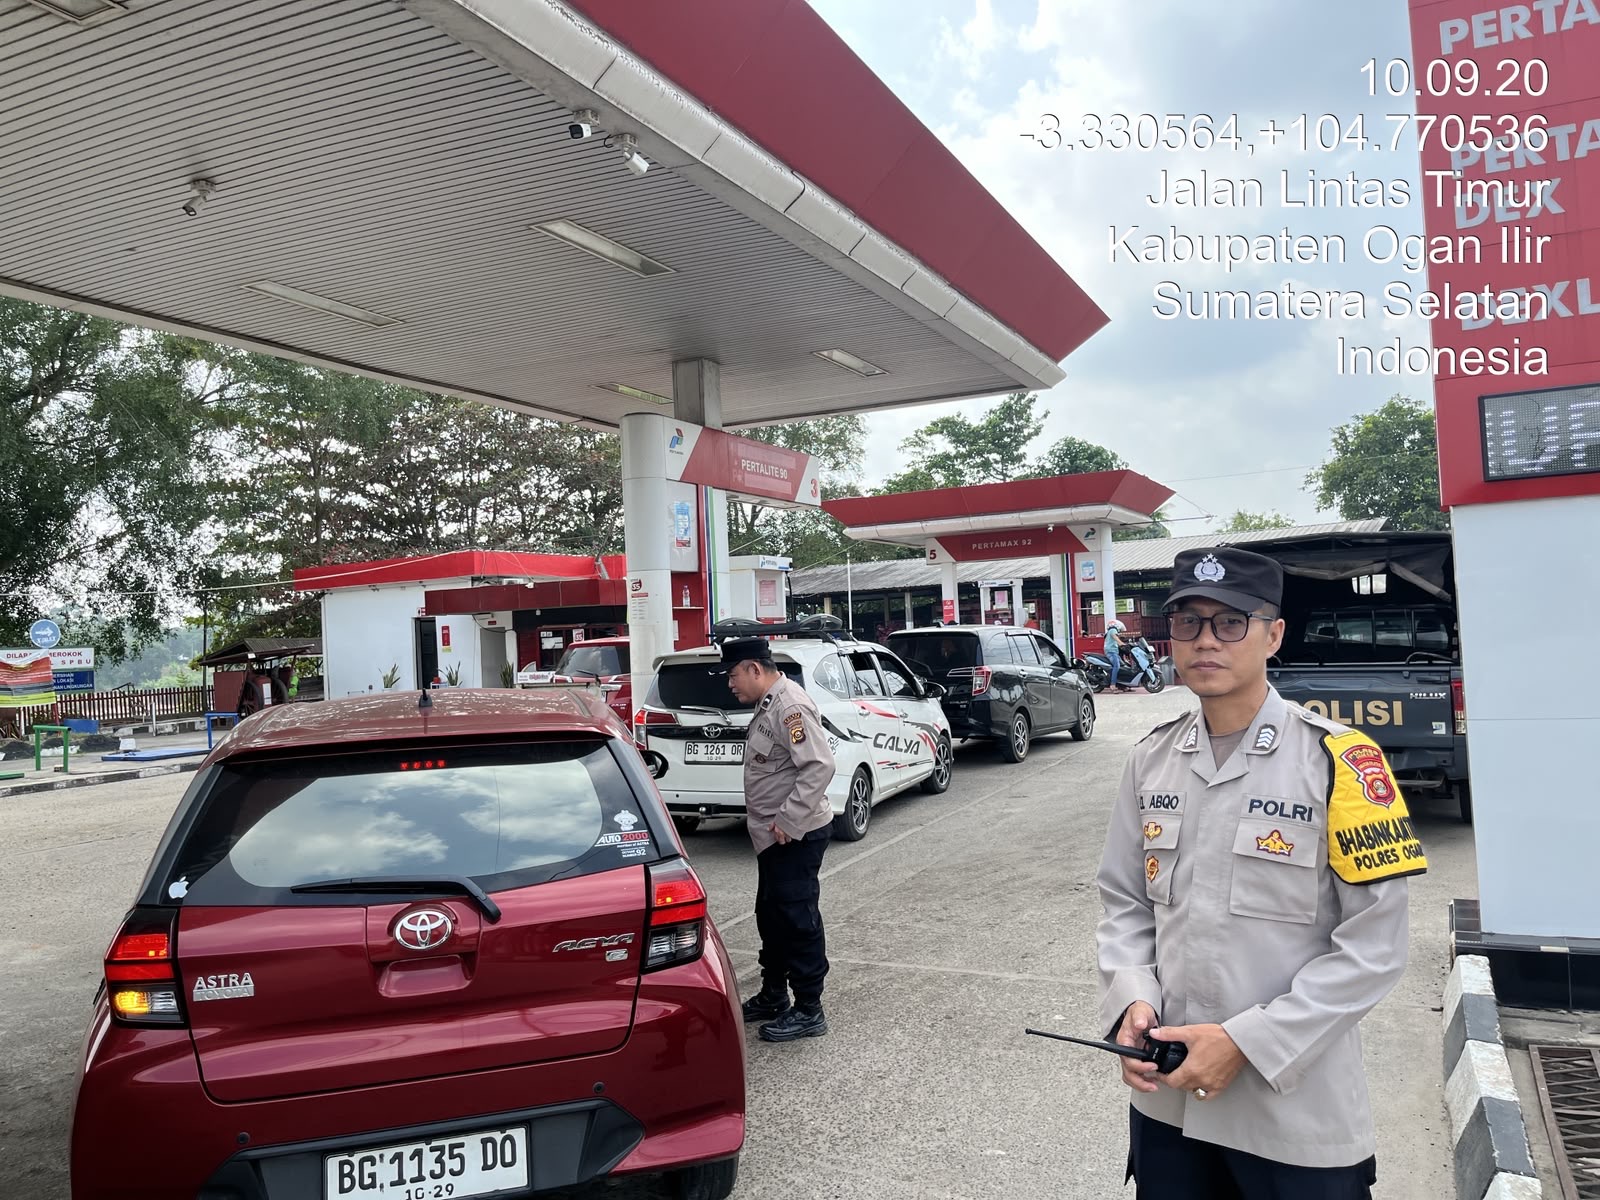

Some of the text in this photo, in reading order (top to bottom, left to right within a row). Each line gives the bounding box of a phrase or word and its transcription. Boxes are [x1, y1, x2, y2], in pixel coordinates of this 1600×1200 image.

[1439, 0, 1600, 55] PERTA
[741, 459, 788, 480] PERTALITE 90
[810, 478, 819, 498] 3
[972, 539, 1019, 550] PERTAMAX
[929, 550, 937, 560] 5
[1409, 692, 1447, 700] HILUX
[1294, 700, 1404, 726] OLISI
[687, 744, 698, 755] BG
[704, 744, 726, 756] 1261
[873, 732, 921, 756] CALYA
[1249, 799, 1313, 823] POLRI
[596, 832, 649, 845] AUTO 2000
[1354, 848, 1400, 871] POLRES
[552, 933, 635, 952] AGYA
[193, 973, 254, 990] ASTRA
[338, 1155, 377, 1194] BG
[389, 1142, 465, 1187] 1135
